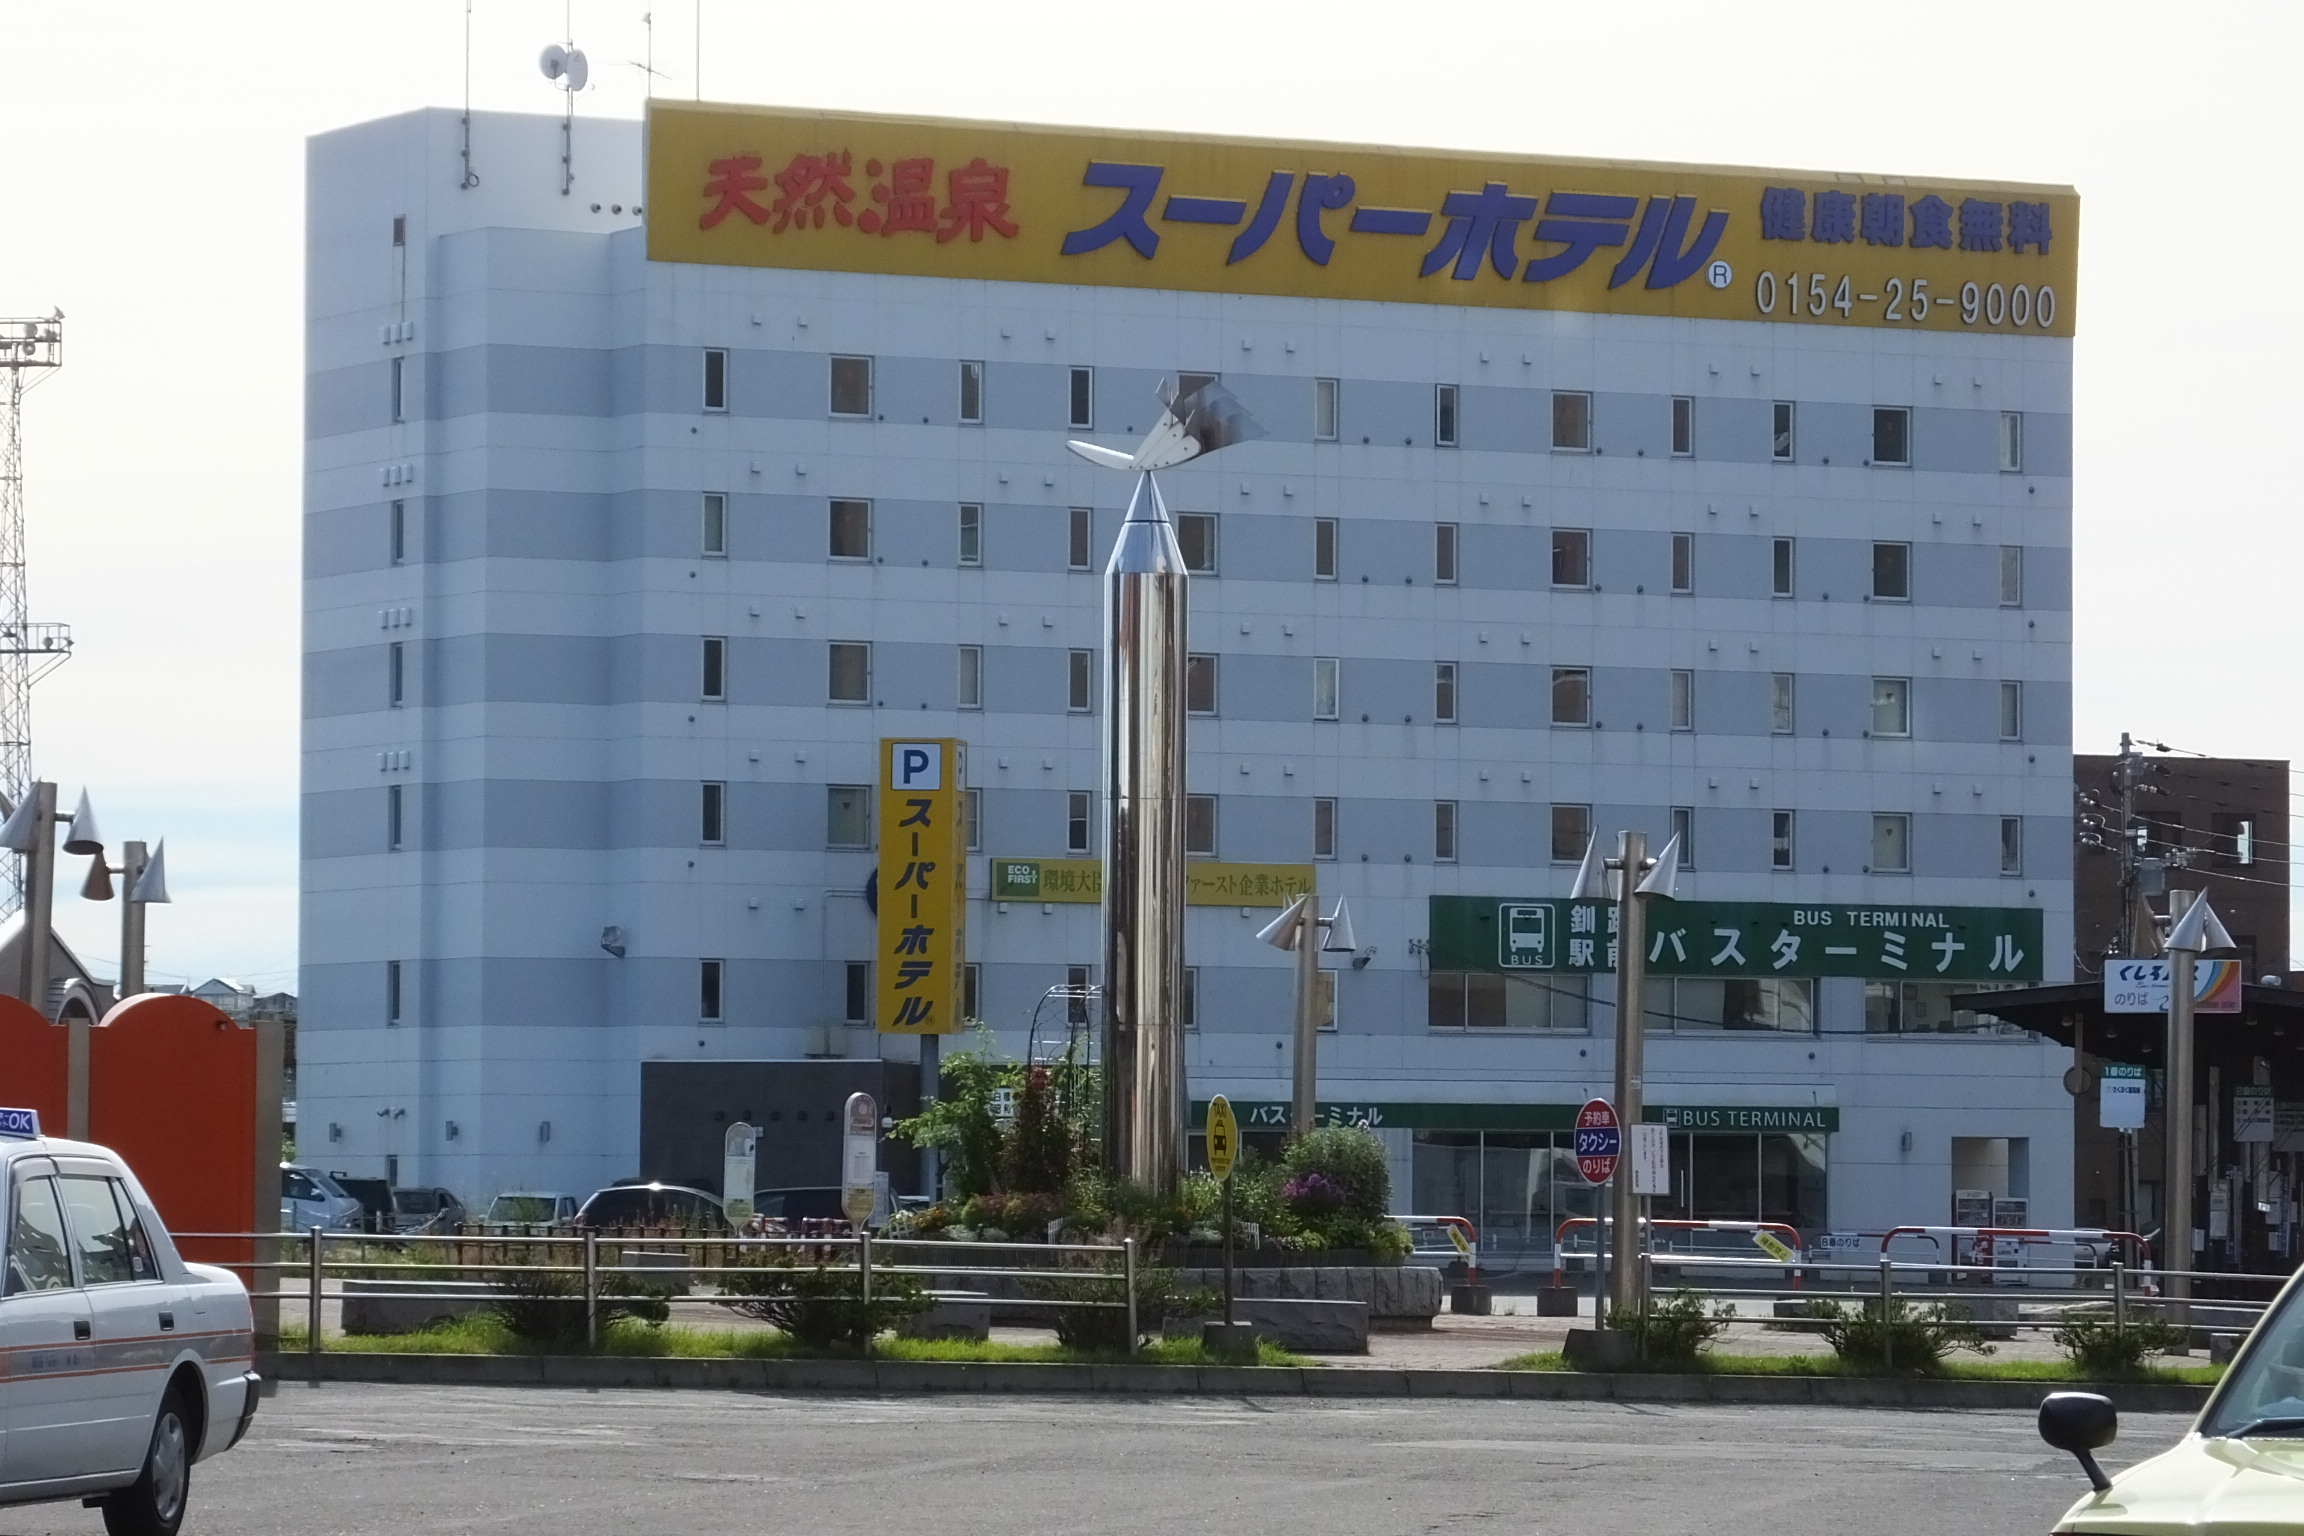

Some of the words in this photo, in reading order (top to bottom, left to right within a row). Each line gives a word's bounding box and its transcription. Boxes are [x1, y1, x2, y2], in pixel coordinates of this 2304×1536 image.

[699, 149, 1020, 244] 天然温泉
[1061, 159, 1730, 290] スーパーホテル
[1760, 186, 2053, 256] 健康朝食無料
[1756, 270, 2056, 329] 0154-25-9000
[903, 749, 930, 785] P
[1007, 865, 1030, 875] ECO
[1007, 873, 1037, 884] FIRST
[1186, 873, 1312, 897] ァースト企業ホテル
[892, 798, 936, 1028] スーパーホテル
[1793, 910, 1832, 926] BUS
[1846, 910, 1950, 928] TERMINAL
[1649, 927, 2025, 974] バスターミナル
[1510, 955, 1544, 966] BUS
[2119, 965, 2199, 981] くしろ
[2114, 991, 2149, 1006] のりば
[9, 1112, 31, 1130] OK
[1250, 1106, 1384, 1126] バスーミナル
[1584, 1111, 1610, 1126] 予約車
[1683, 1110, 1720, 1127] BUS
[1727, 1110, 1827, 1128] TERMINAL
[1578, 1132, 1618, 1153] タクシー
[1582, 1158, 1611, 1174] のりば
